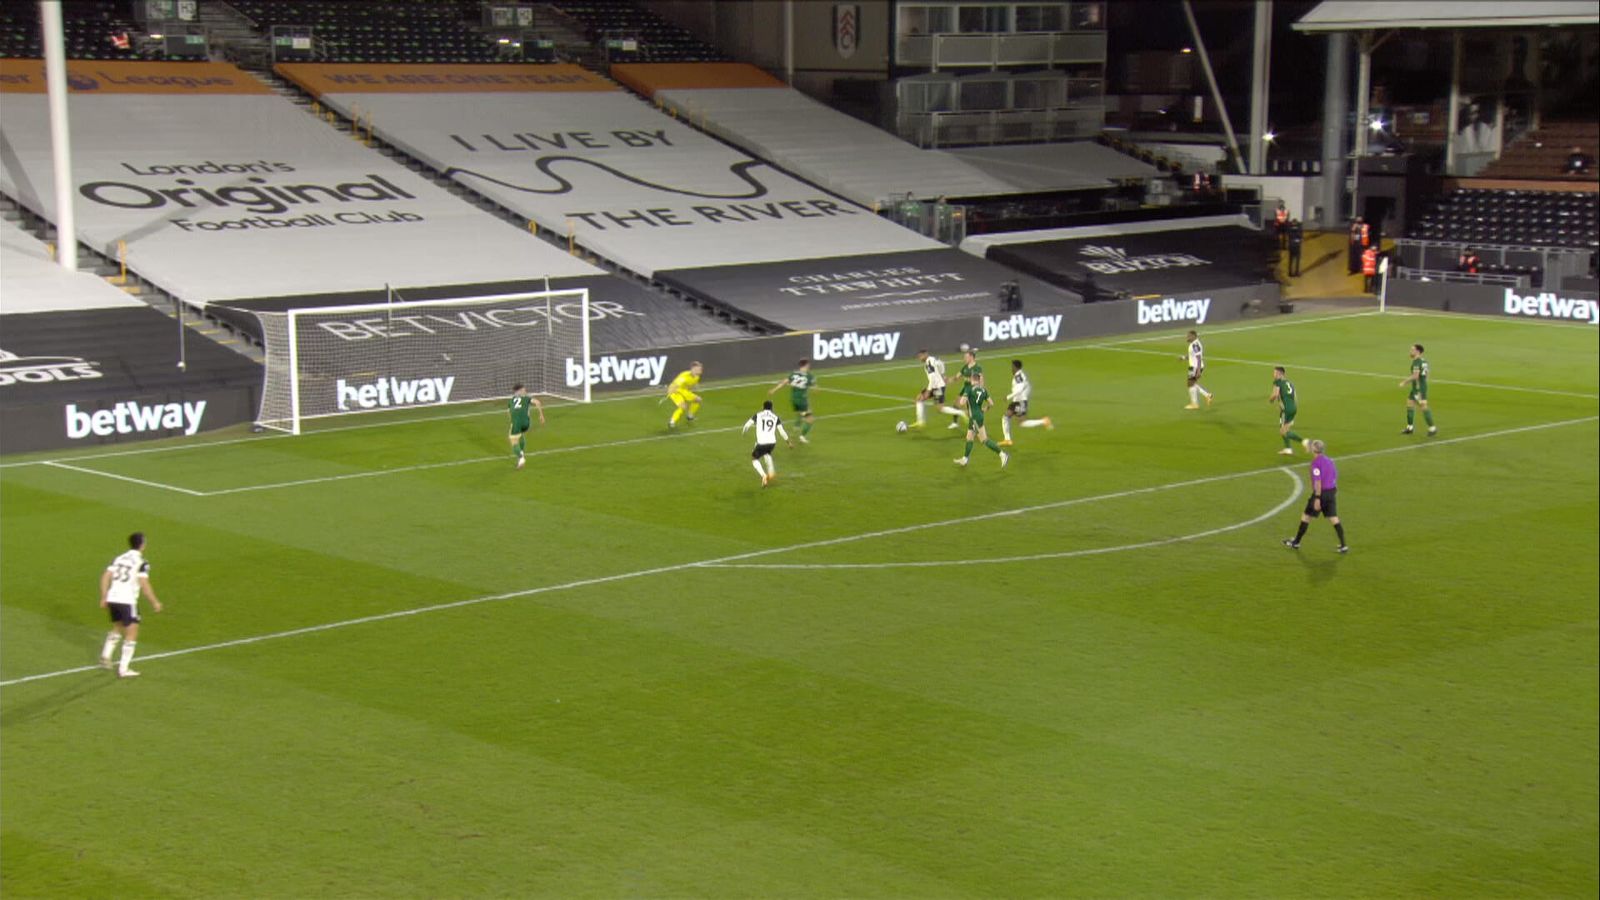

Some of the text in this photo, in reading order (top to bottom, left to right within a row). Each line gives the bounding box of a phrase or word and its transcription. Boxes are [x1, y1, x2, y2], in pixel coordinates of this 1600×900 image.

[450, 130, 674, 151] I LIVE BY
[120, 160, 296, 177] London's
[79, 174, 416, 214] Original
[170, 210, 424, 233] Football Club
[564, 199, 857, 230] THE RIVER
[789, 267, 920, 283] CHARLES
[1137, 298, 1211, 325] betway
[1504, 287, 1599, 324] betway
[982, 314, 1063, 342] betway
[812, 331, 900, 361] betway
[565, 355, 668, 387] betway
[791, 374, 808, 389] 22
[336, 375, 455, 410] betway
[975, 391, 982, 404] 7
[1285, 381, 1293, 394] 3
[513, 397, 522, 409] 2
[66, 400, 207, 439] betway
[761, 419, 774, 432] 19
[112, 562, 132, 583] 33
